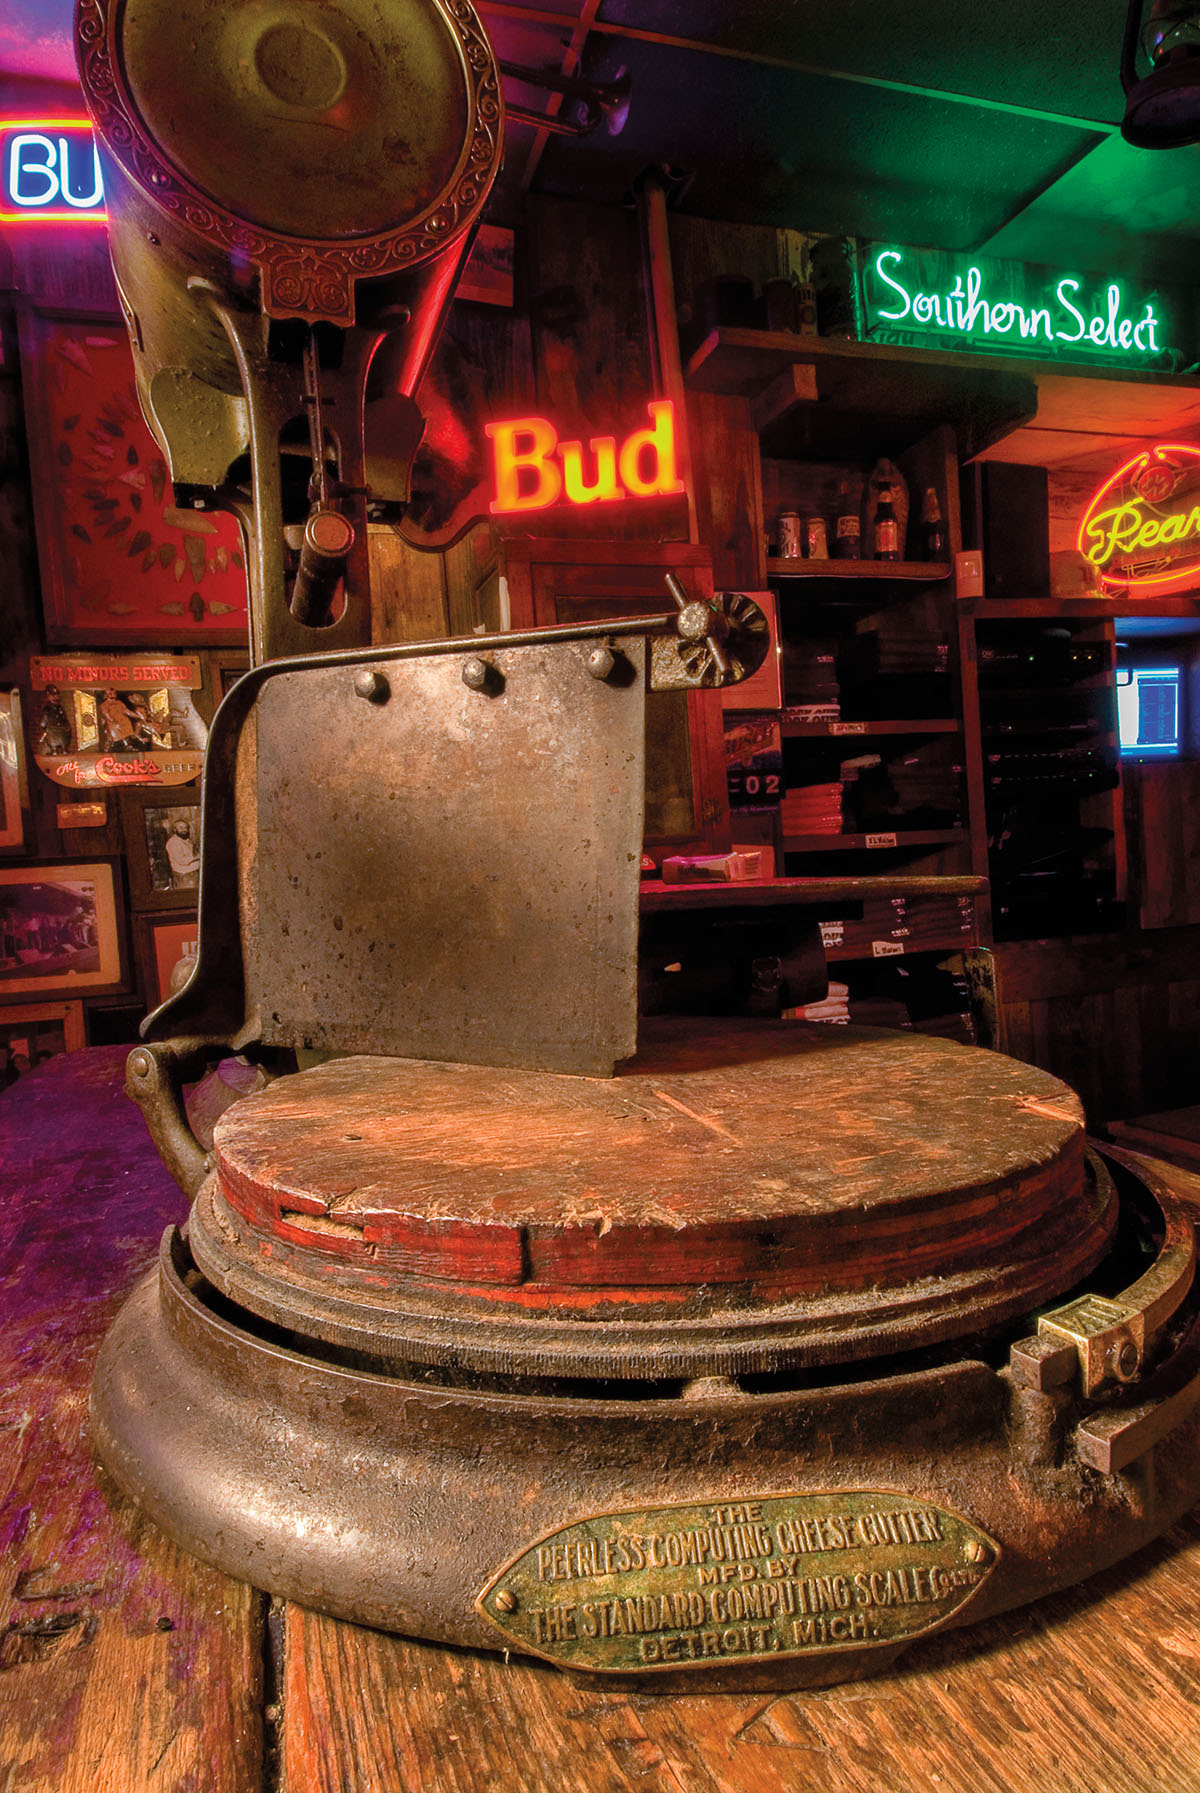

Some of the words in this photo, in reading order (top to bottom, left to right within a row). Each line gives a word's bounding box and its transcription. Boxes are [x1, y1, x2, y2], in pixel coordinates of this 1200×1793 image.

[9, 134, 103, 208] BU
[876, 250, 1054, 340] Southern
[1056, 278, 1159, 352] Select
[484, 399, 685, 514] Bud
[40, 666, 63, 681] NO
[67, 665, 129, 681] MINORS
[536, 1535, 648, 1583] PEERLESS
[650, 1523, 774, 1569] COMPUTING
[775, 1514, 860, 1555] CHEESE
[857, 1507, 944, 1547] CUTTER
[711, 1503, 763, 1526] THE
[529, 1603, 578, 1644] THE
[582, 1591, 706, 1639] STANDARD
[709, 1573, 850, 1624] COMPUTING
[854, 1566, 931, 1608] SCALE
[698, 1561, 763, 1585] MFD.
[766, 1556, 799, 1579] BY
[792, 1612, 880, 1646] MICH.
